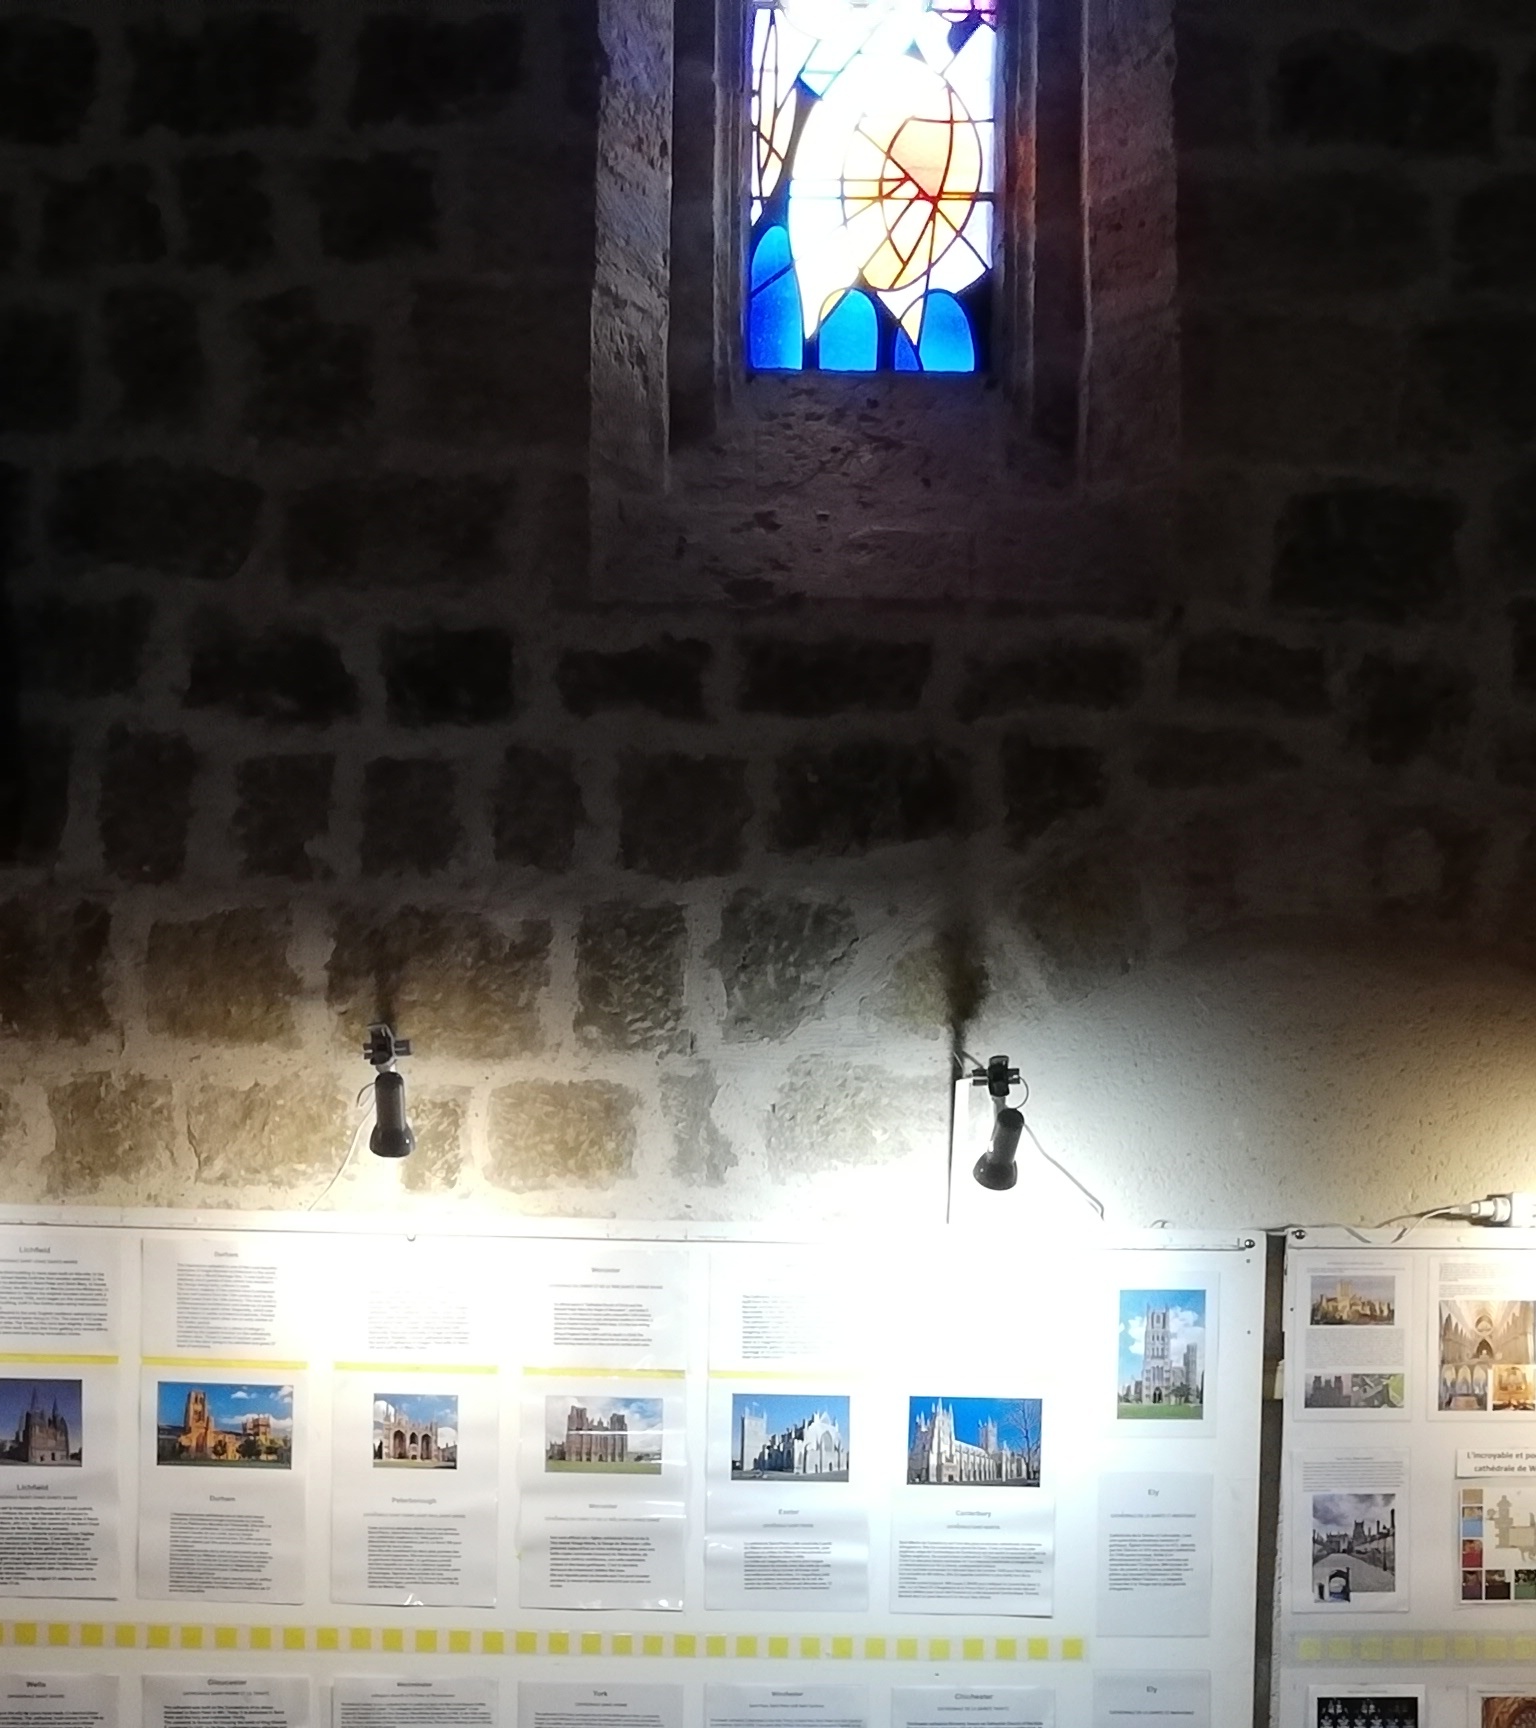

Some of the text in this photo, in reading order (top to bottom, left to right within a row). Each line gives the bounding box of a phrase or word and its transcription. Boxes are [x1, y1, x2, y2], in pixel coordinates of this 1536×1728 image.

[1466, 1451, 1513, 1461] L'incroyable
[1515, 1451, 1523, 1459] et
[1473, 1464, 1515, 1472] cathédrale
